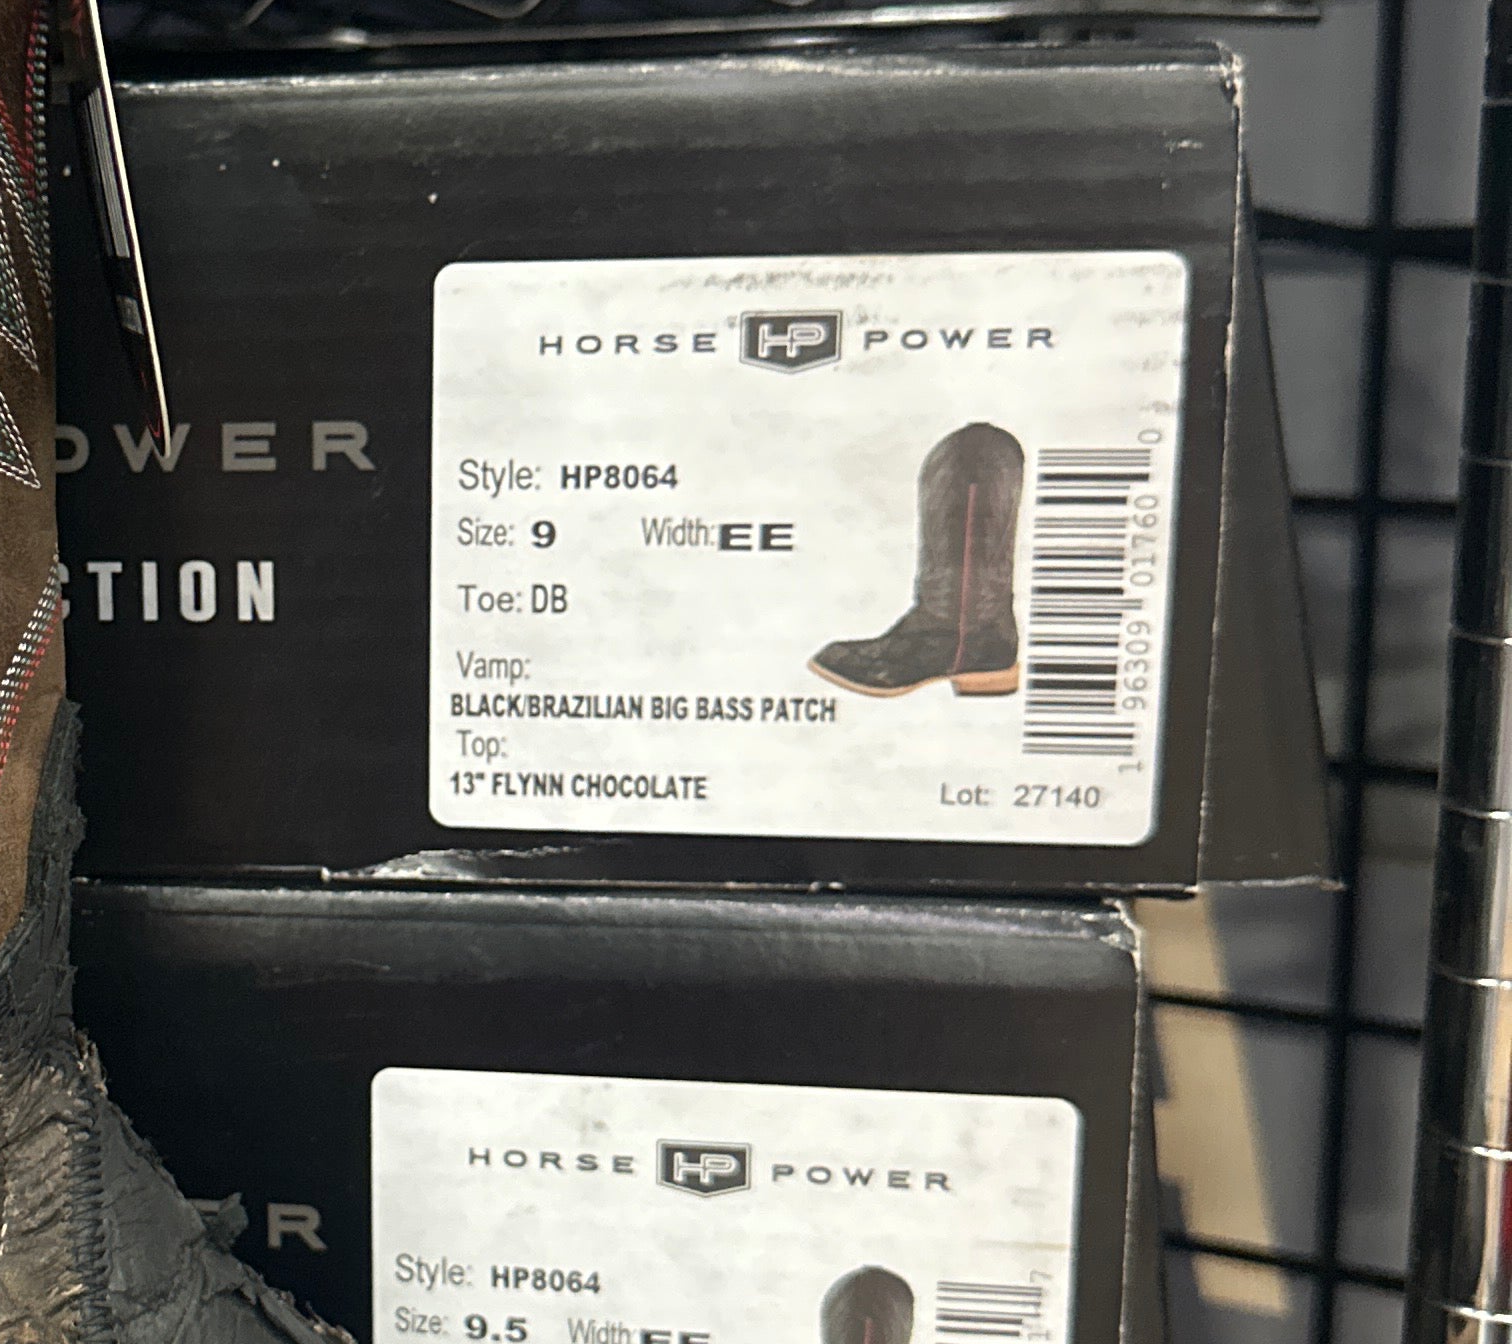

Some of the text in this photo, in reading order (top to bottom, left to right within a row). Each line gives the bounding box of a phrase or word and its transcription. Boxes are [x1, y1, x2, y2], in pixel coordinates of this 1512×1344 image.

[539, 332, 718, 356] HORSE
[863, 327, 1055, 351] POWER
[458, 459, 679, 498] Style: HP8064
[457, 517, 795, 552] Size: 9 Width: EE
[1130, 493, 1159, 588] 01760
[457, 586, 568, 614] Toe: DB
[457, 652, 531, 686] Vamp:
[1122, 620, 1151, 712] 96309
[450, 693, 837, 723] BLACK/BRAZILIAN BIG BASS PATCH
[458, 730, 508, 763] Top:
[450, 771, 708, 801] 13" FLYNN CHOCOLATE
[941, 783, 1101, 809] Lot: 27140
[467, 1146, 636, 1174] HORSE
[770, 1162, 952, 1192] POWER
[395, 1254, 601, 1295] Style: HP8064
[395, 1307, 449, 1336] Size:
[463, 1314, 529, 1344] 9.5
